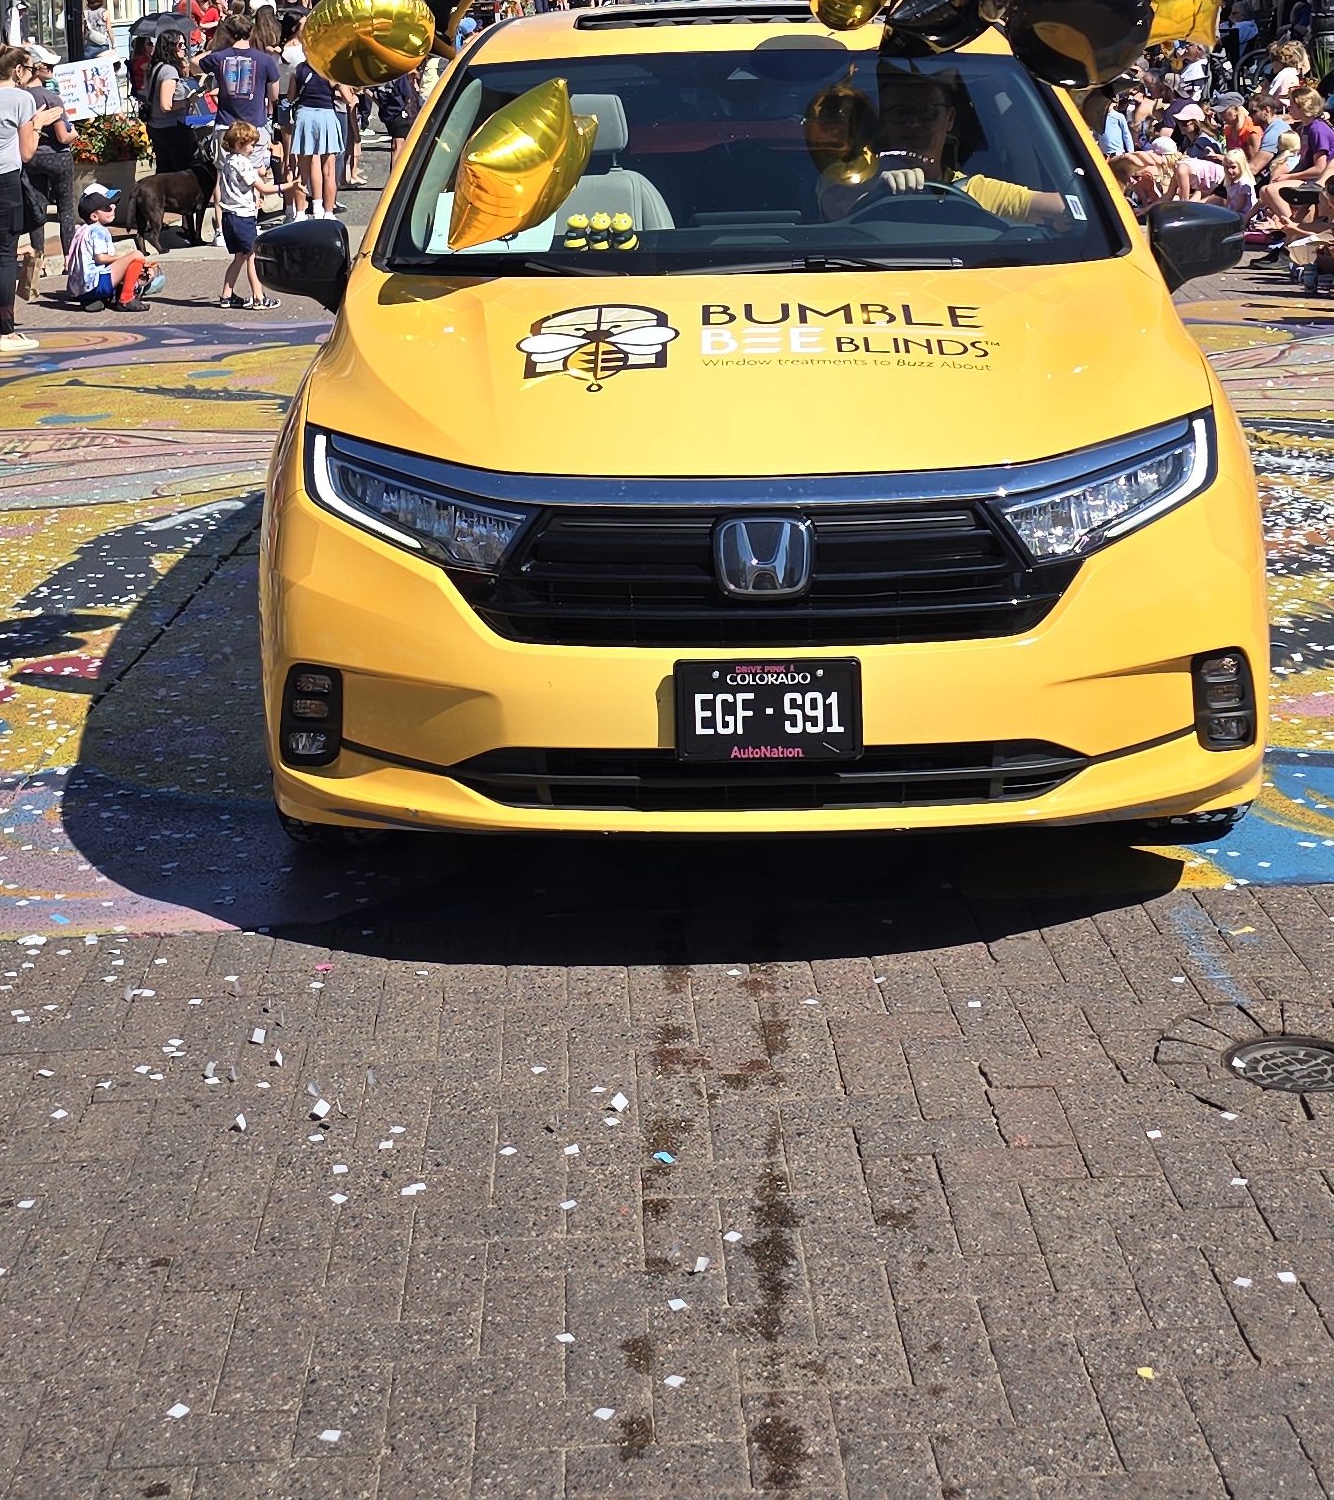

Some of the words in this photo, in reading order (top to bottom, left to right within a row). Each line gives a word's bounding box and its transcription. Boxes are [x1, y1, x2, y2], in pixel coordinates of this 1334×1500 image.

[701, 302, 986, 329] BUMBLE
[700, 326, 827, 355] BEE
[702, 358, 772, 368] Window
[776, 357, 868, 367] treatments
[872, 358, 891, 367] to
[896, 358, 934, 369] Buzz
[940, 360, 992, 372] About
[735, 665, 763, 674] DRIVE
[764, 665, 787, 673] PINK
[726, 671, 811, 686] COLORADO
[694, 692, 755, 736] EGF
[730, 745, 804, 759] AutoNation
